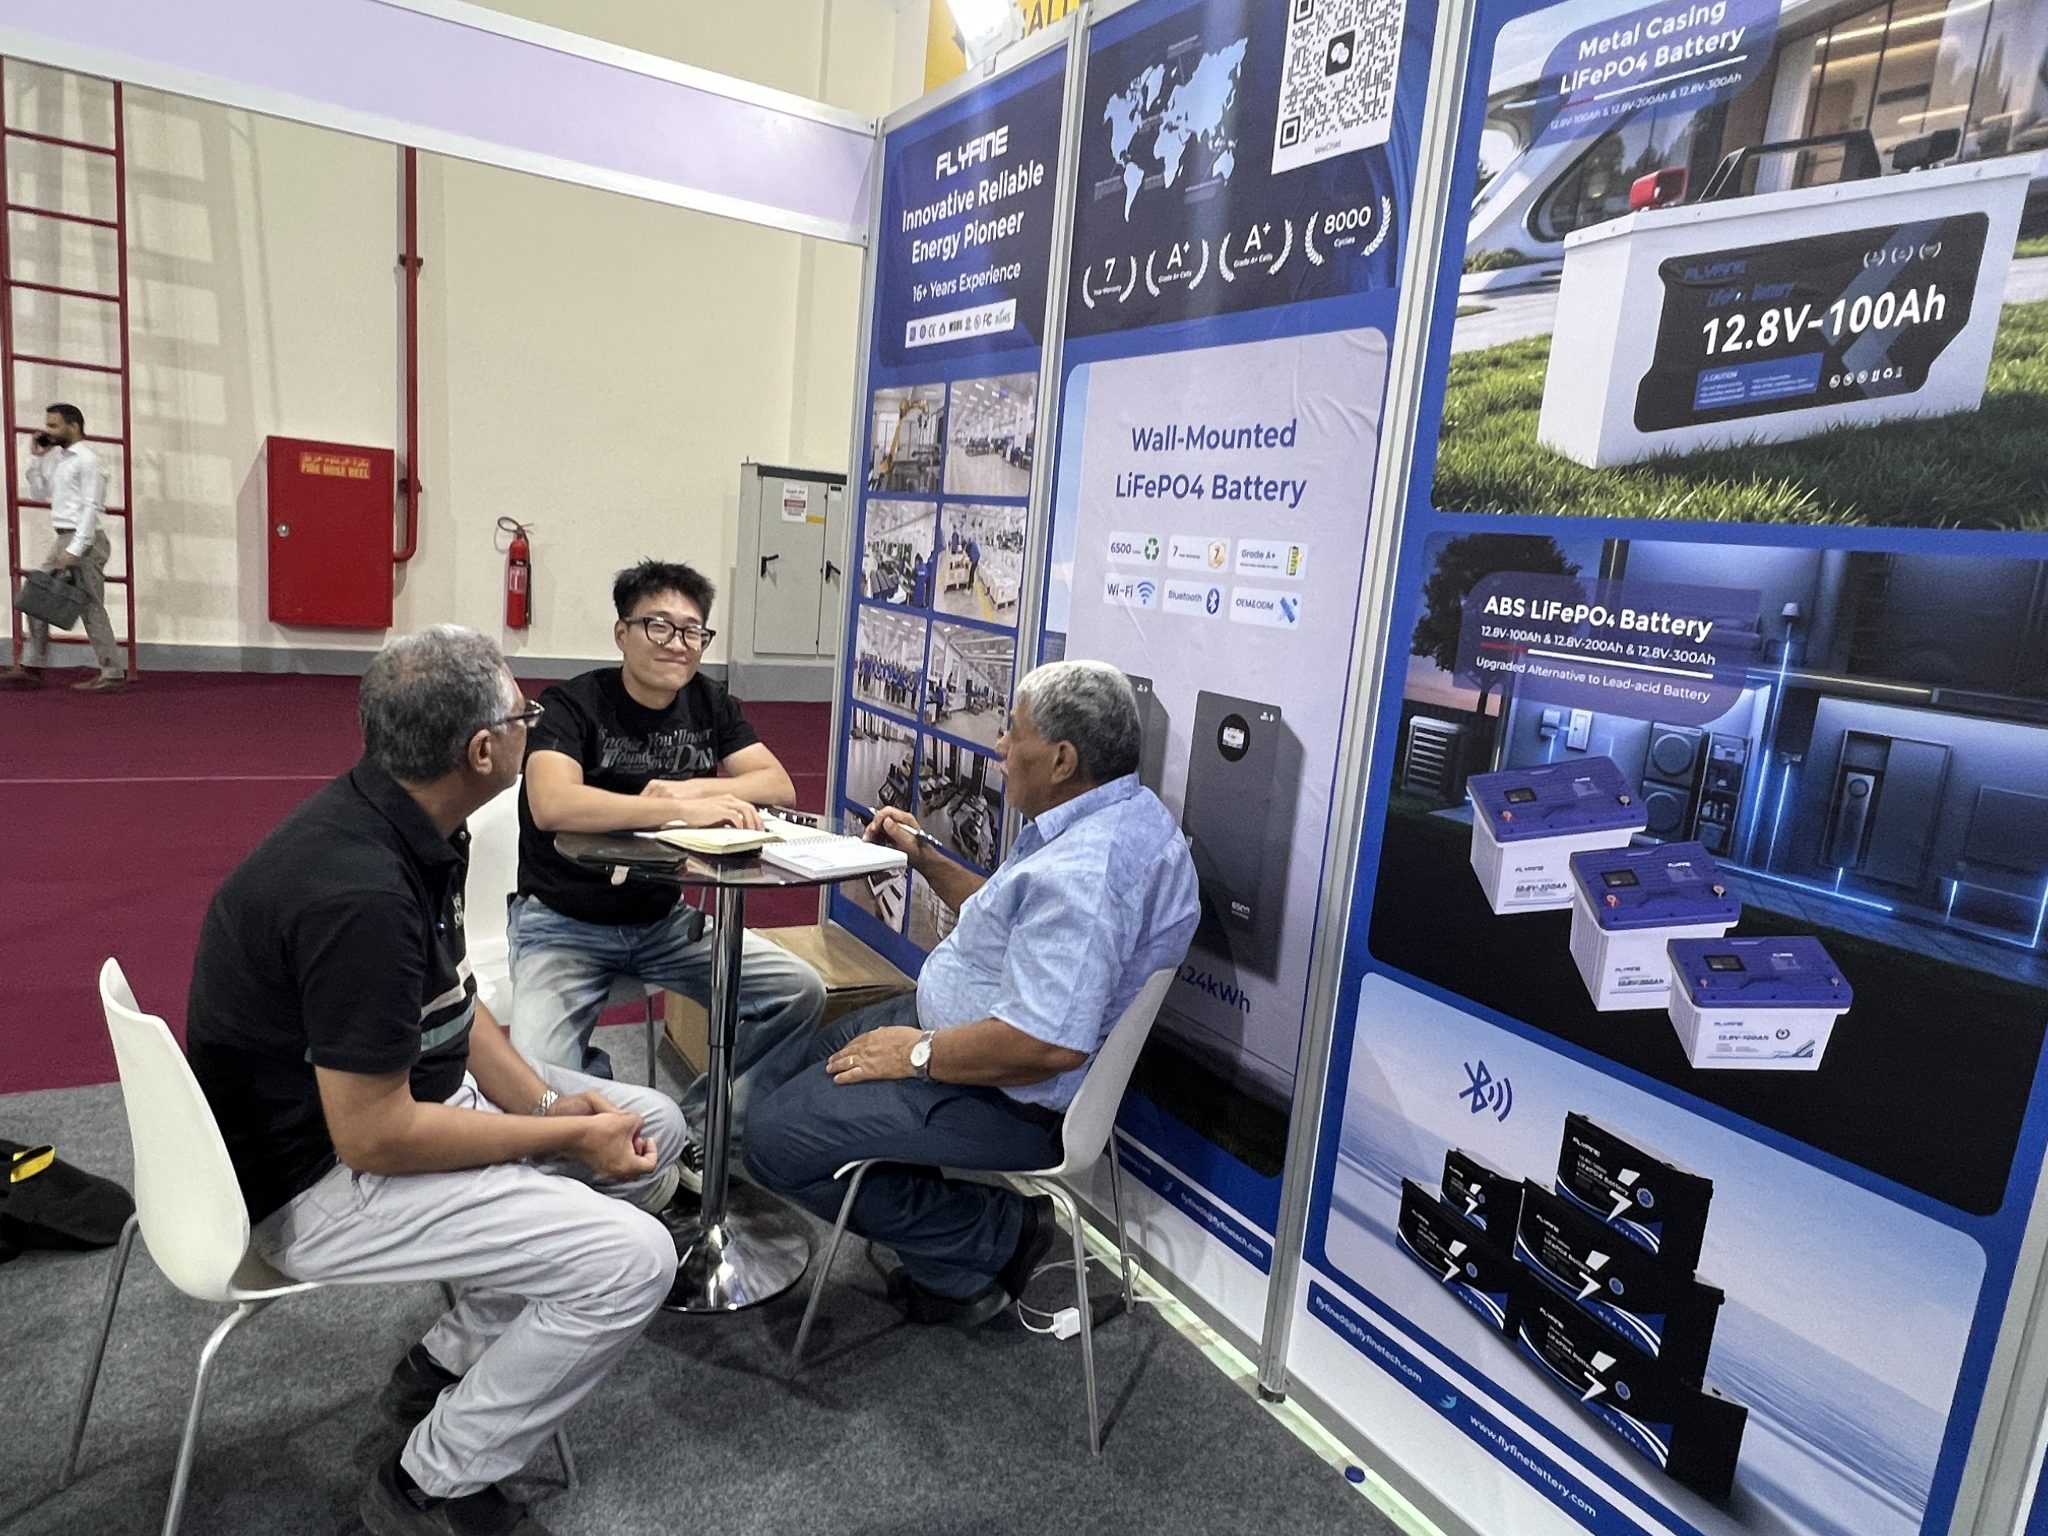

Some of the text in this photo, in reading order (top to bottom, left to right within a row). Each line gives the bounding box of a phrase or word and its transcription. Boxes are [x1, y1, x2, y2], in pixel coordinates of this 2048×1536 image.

[1578, 1, 1727, 61] Metal Casing
[1654, 26, 1746, 68] Battery
[935, 125, 1009, 180] FLYFINE
[902, 189, 975, 232] Innovative
[978, 159, 1044, 207] Reliable
[912, 211, 1024, 264] Energy Pioneer
[1244, 222, 1271, 253] A+
[1324, 206, 1371, 235] 8000
[1167, 241, 1190, 270] A+
[1333, 236, 1355, 248] Cycles
[912, 262, 1022, 303] 16+ Years Experience
[1105, 257, 1116, 282] 7
[1702, 284, 1947, 356] 12.8V-100Ah
[1131, 418, 1297, 452] Wall-Mounted
[1115, 472, 1308, 509] LiFePO4 Battery
[1110, 542, 1132, 555] 6500
[1173, 545, 1179, 558] 7
[1214, 547, 1220, 560] 7
[1241, 549, 1264, 560] Grade
[1107, 584, 1134, 599] Wi-Fi
[1168, 590, 1202, 603] Bluetooth
[1483, 595, 1525, 618] ABS
[1620, 609, 1713, 643] Battery
[1481, 625, 1716, 666] 12.8V-100Ah & 12.8V-200Ah & 12.8V-300Ah
[1476, 656, 1711, 704] Upgraded Alternative to Lead-acid Battery
[1470, 1415, 1597, 1518] www.flyfinebattery.com
